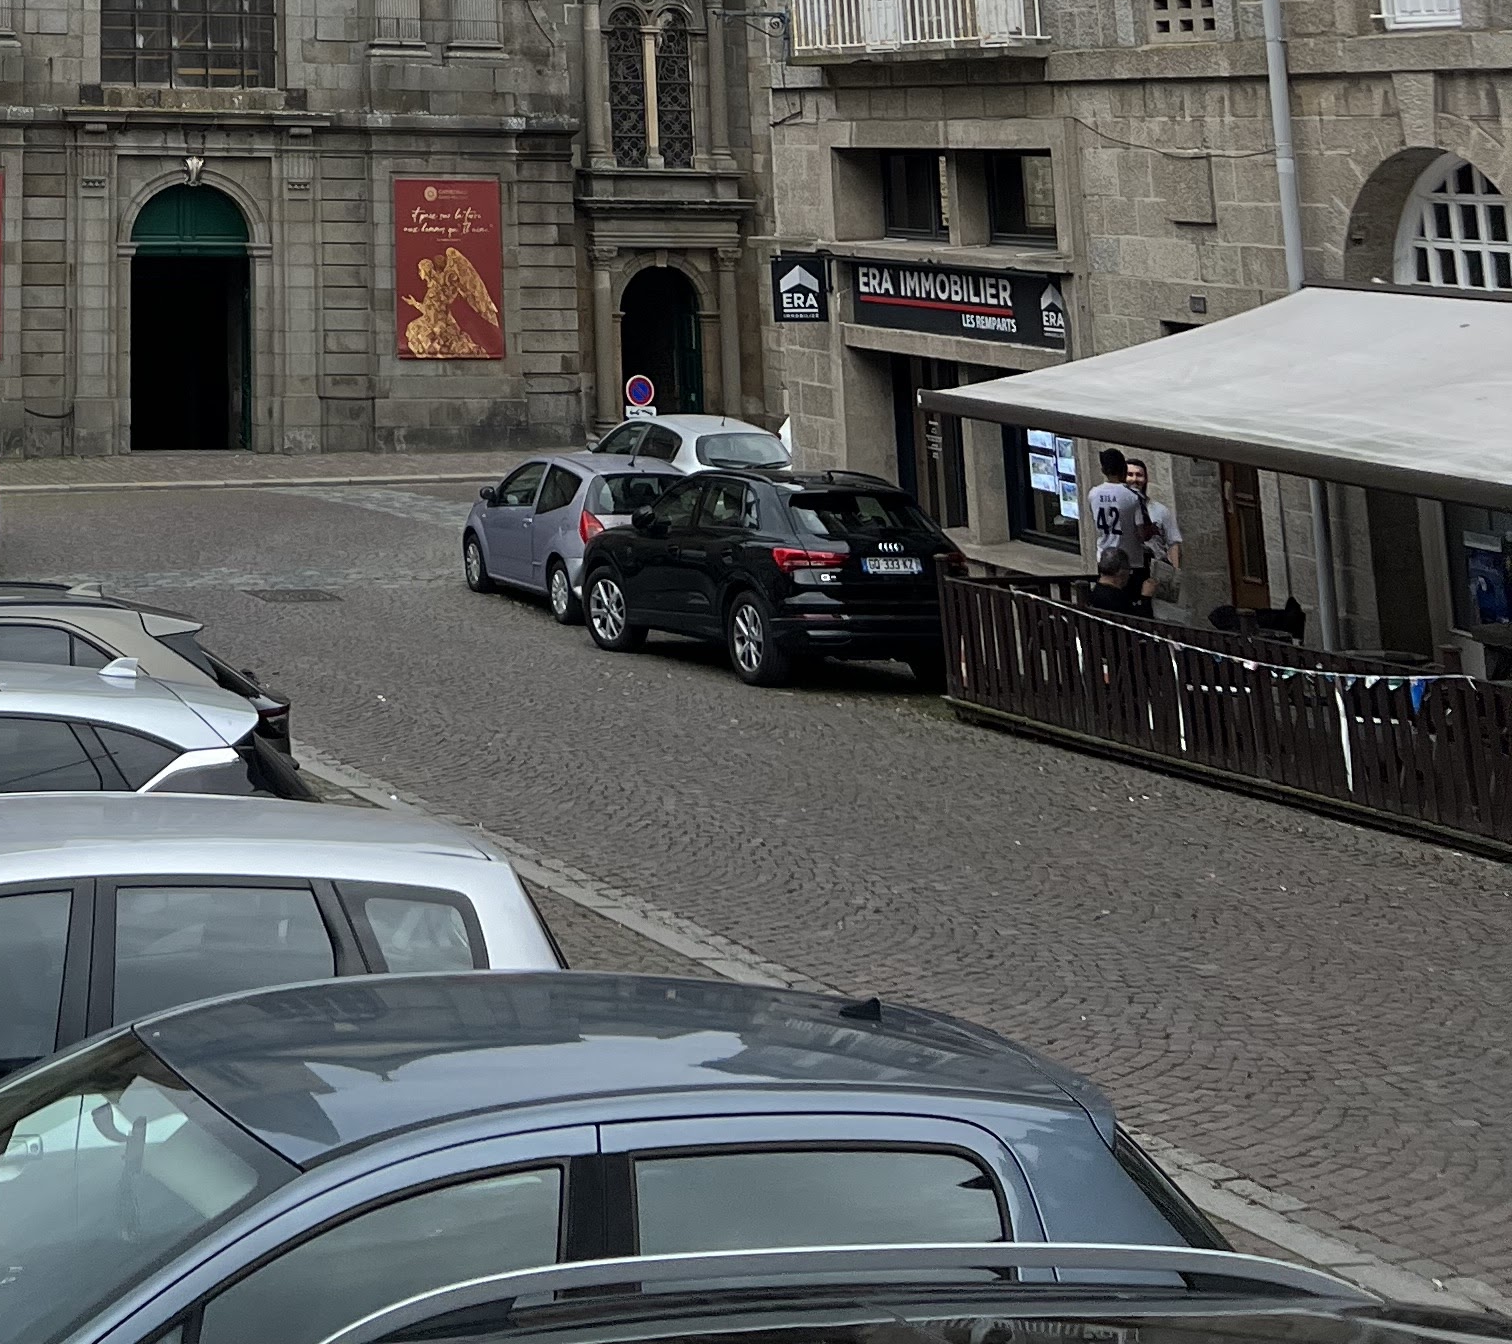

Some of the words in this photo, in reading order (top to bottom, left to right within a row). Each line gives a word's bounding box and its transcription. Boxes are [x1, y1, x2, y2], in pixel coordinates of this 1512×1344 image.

[858, 266, 894, 295] ERA
[899, 269, 1013, 307] IMMOBILIER
[782, 292, 819, 308] ERA
[961, 313, 976, 328] LES
[976, 315, 1017, 333] REMPARTS
[1042, 310, 1065, 328] ERA
[1096, 506, 1123, 535] 42
